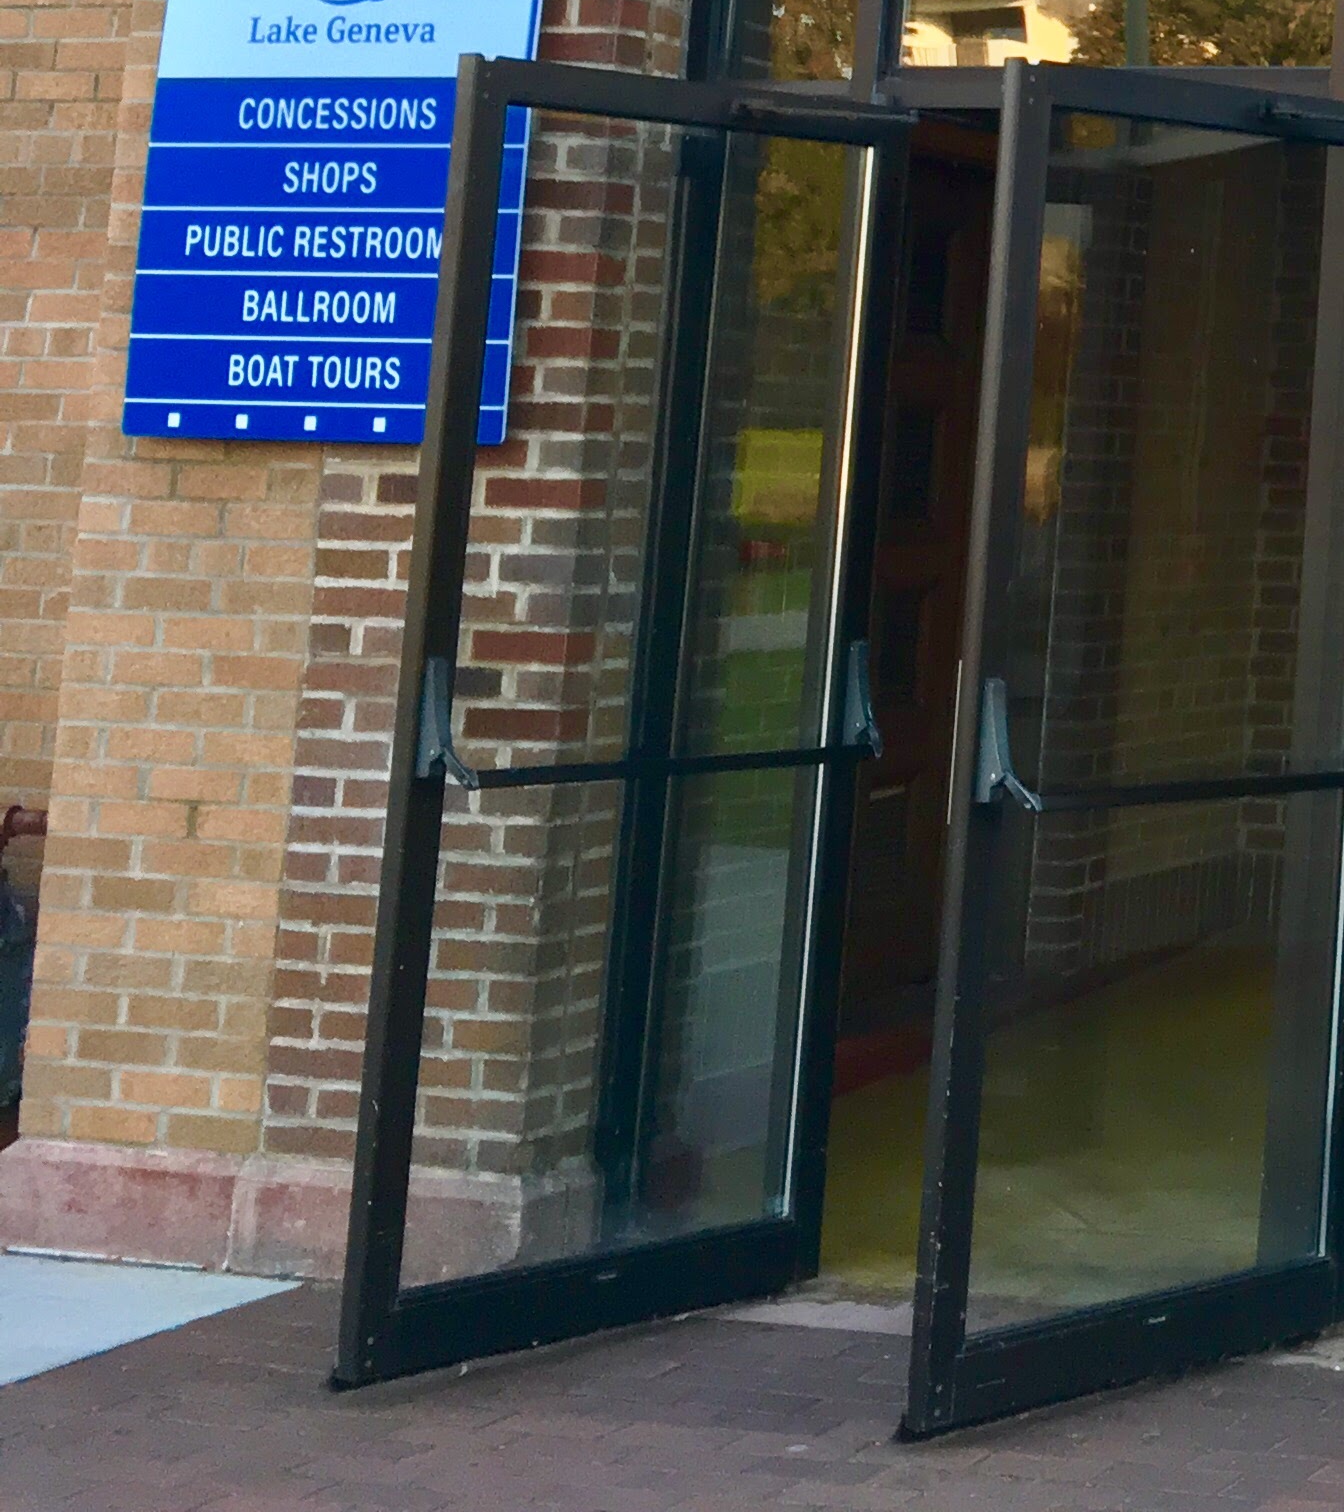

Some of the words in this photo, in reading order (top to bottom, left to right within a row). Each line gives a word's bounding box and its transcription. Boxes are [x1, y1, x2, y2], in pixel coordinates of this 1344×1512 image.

[247, 17, 317, 45] Lake
[327, 16, 435, 45] Geneva
[239, 98, 437, 130] CONCESSIONS
[283, 162, 377, 194] SHOPS
[185, 225, 283, 258] PUBLIC
[242, 290, 396, 324] BALLROOM
[228, 354, 299, 388] BOAT
[308, 356, 400, 390] TOURS
